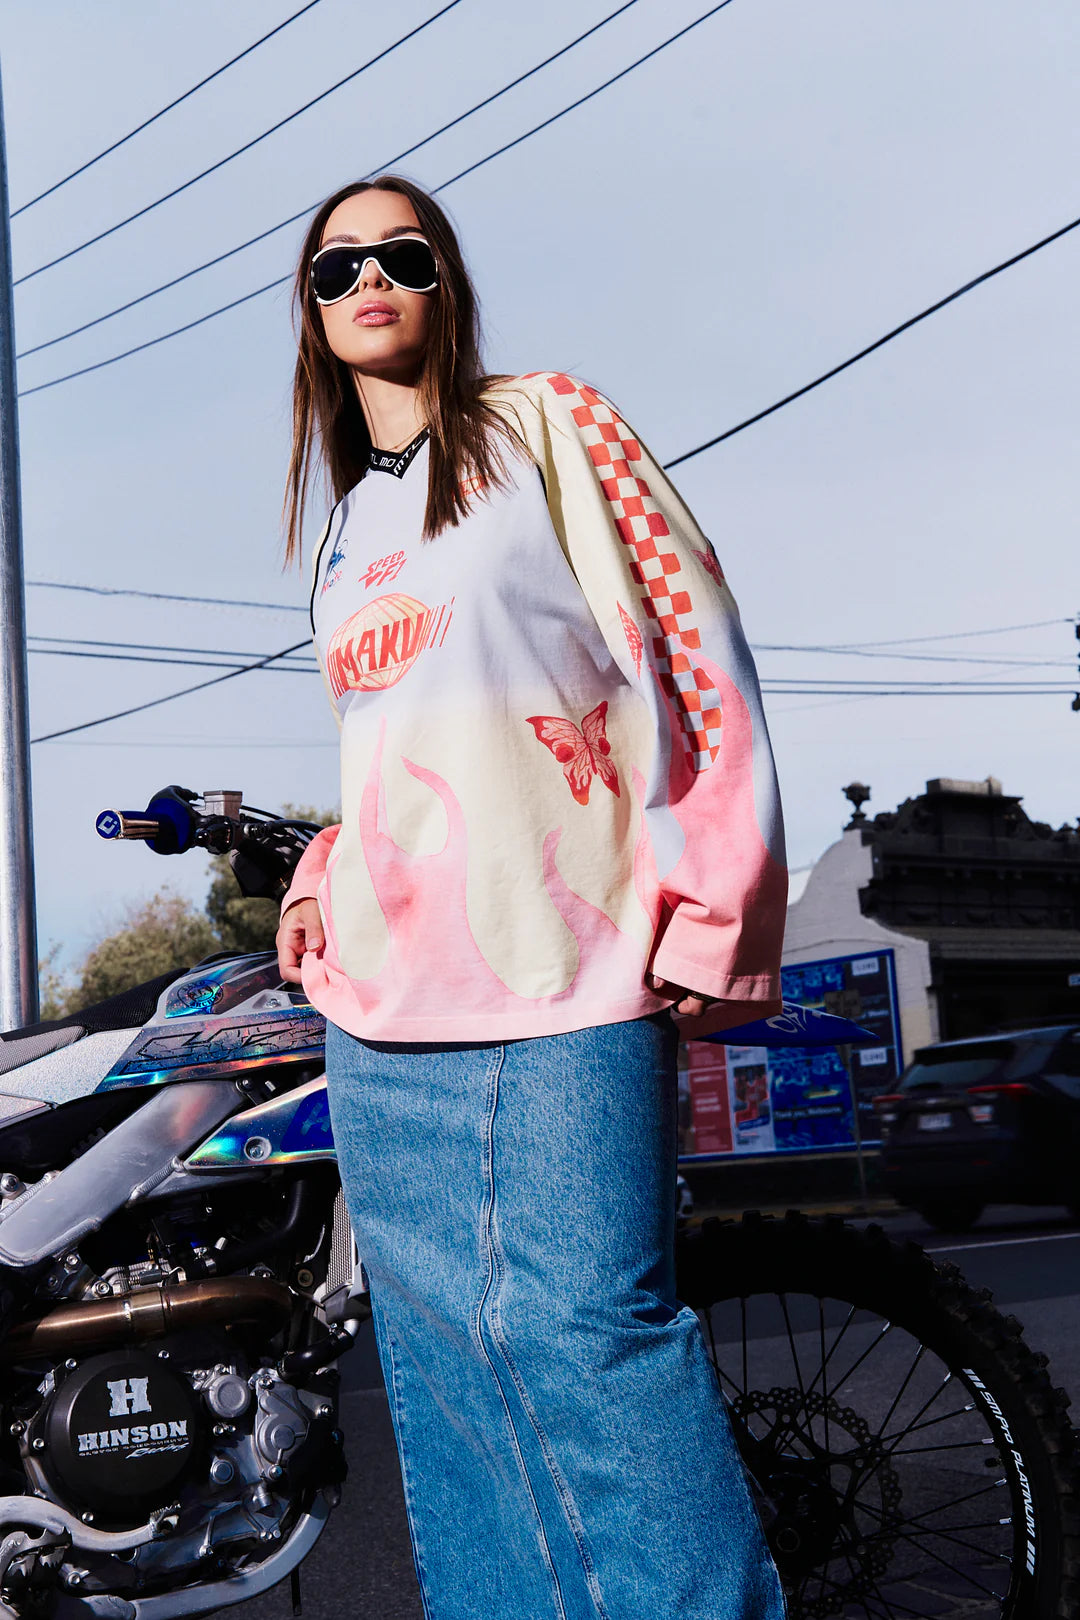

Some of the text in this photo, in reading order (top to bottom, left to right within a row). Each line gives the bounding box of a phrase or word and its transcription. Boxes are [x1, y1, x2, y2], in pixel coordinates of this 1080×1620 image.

[358, 550, 405, 582] SPEED
[106, 1376, 152, 1417] H
[78, 1420, 187, 1452] HINSON
[1011, 1449, 1036, 1538] PLATINUM
